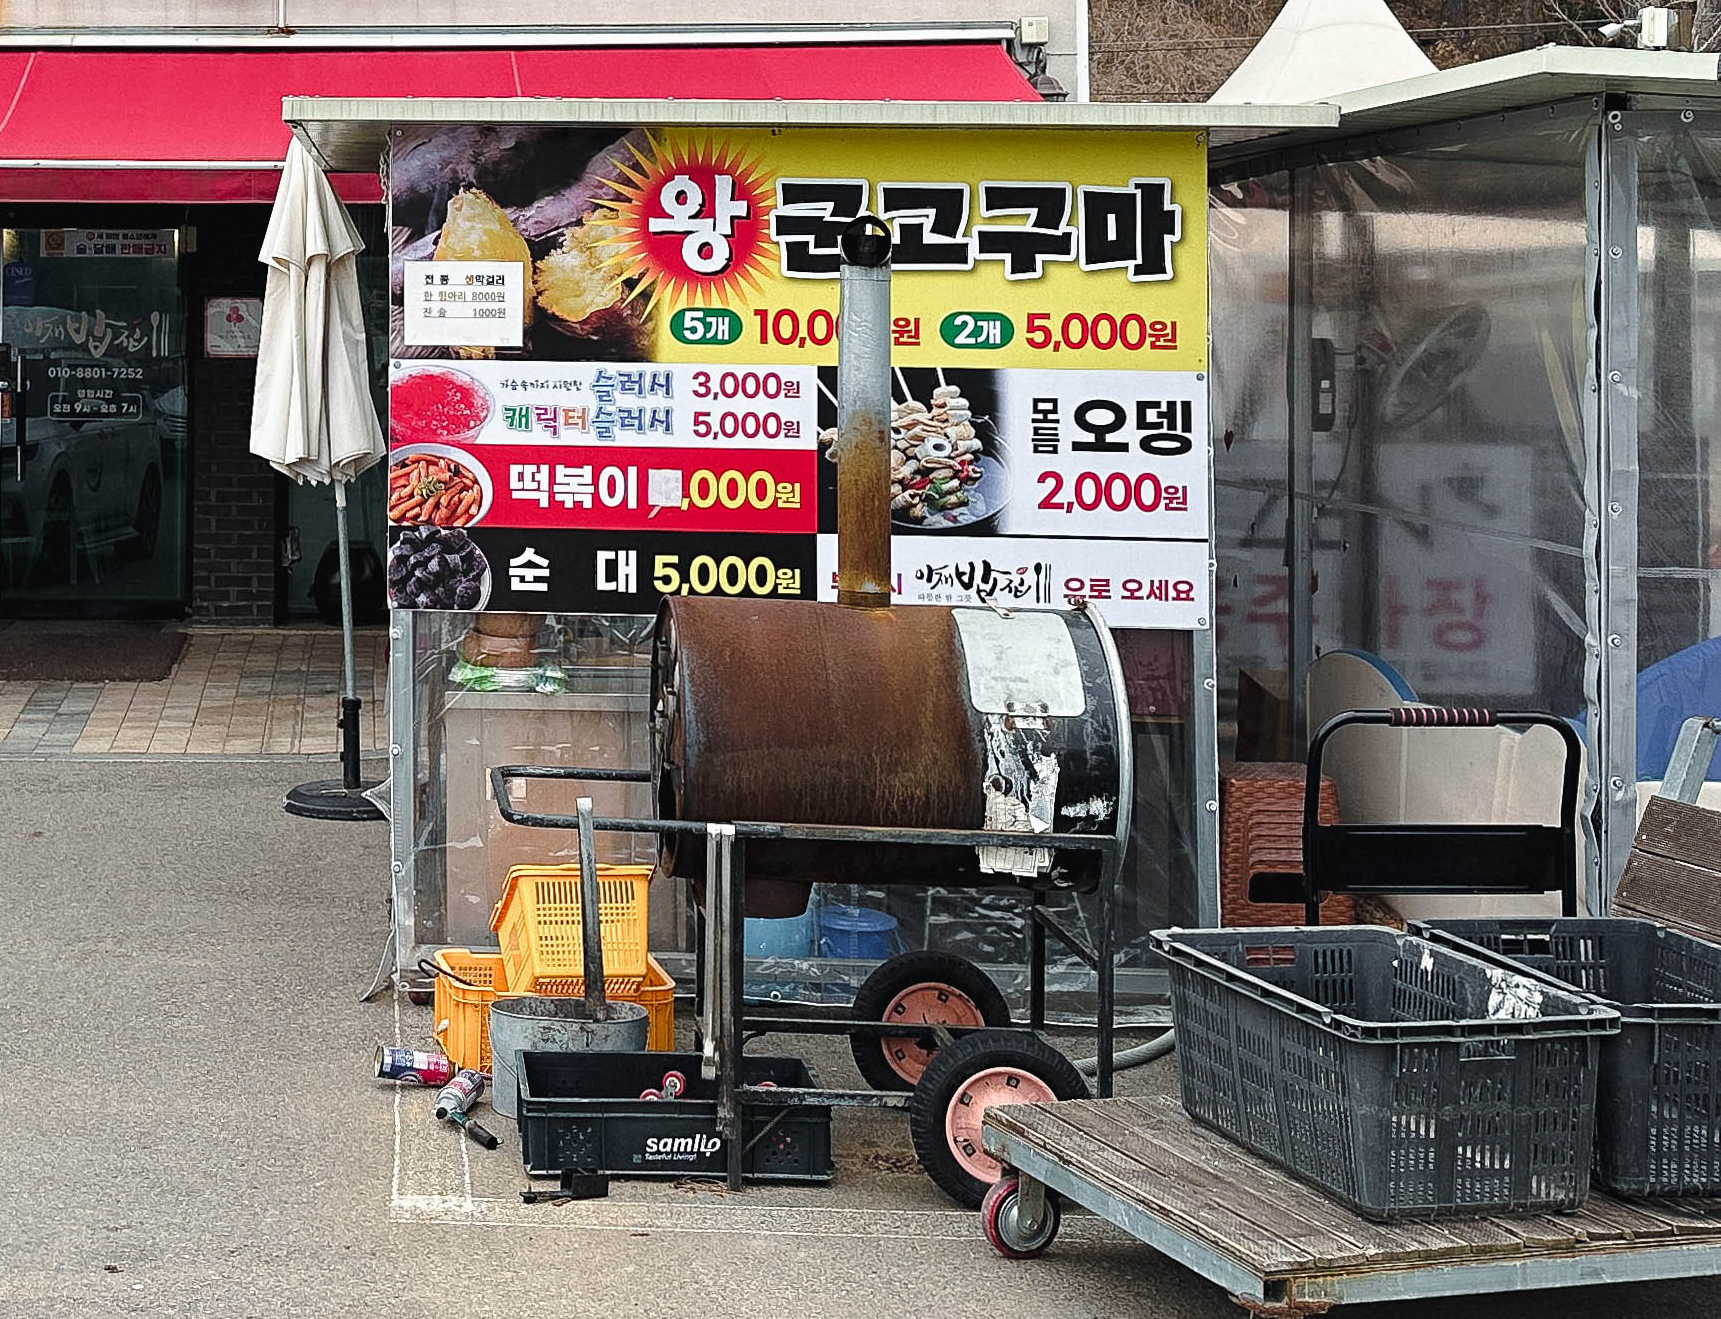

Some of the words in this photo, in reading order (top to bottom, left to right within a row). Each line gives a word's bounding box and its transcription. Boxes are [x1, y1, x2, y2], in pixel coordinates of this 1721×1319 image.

[648, 175, 751, 273] 왕
[769, 177, 1182, 282] 군고구마
[472, 307, 506, 317] 1000원
[682, 313, 730, 342] 5개
[753, 308, 921, 349] 10,0원
[952, 314, 1002, 343] 2개
[1025, 312, 1179, 352] 5,000원
[47, 367, 143, 379] 010-8801-7252
[590, 368, 674, 404] 슬러시
[691, 371, 802, 401] 3,000원
[121, 402, 137, 413] 7시
[692, 411, 802, 440] 5,000원
[1031, 397, 1060, 454] 모듬
[1071, 399, 1193, 456] 오뎅
[509, 463, 638, 510] 떡볶이
[647, 468, 802, 511] ,000원
[1036, 470, 1188, 514] 2,000원
[652, 553, 802, 596] 5,000원
[1120, 577, 1195, 602] 오세요
[645, 1133, 721, 1157] samlip
